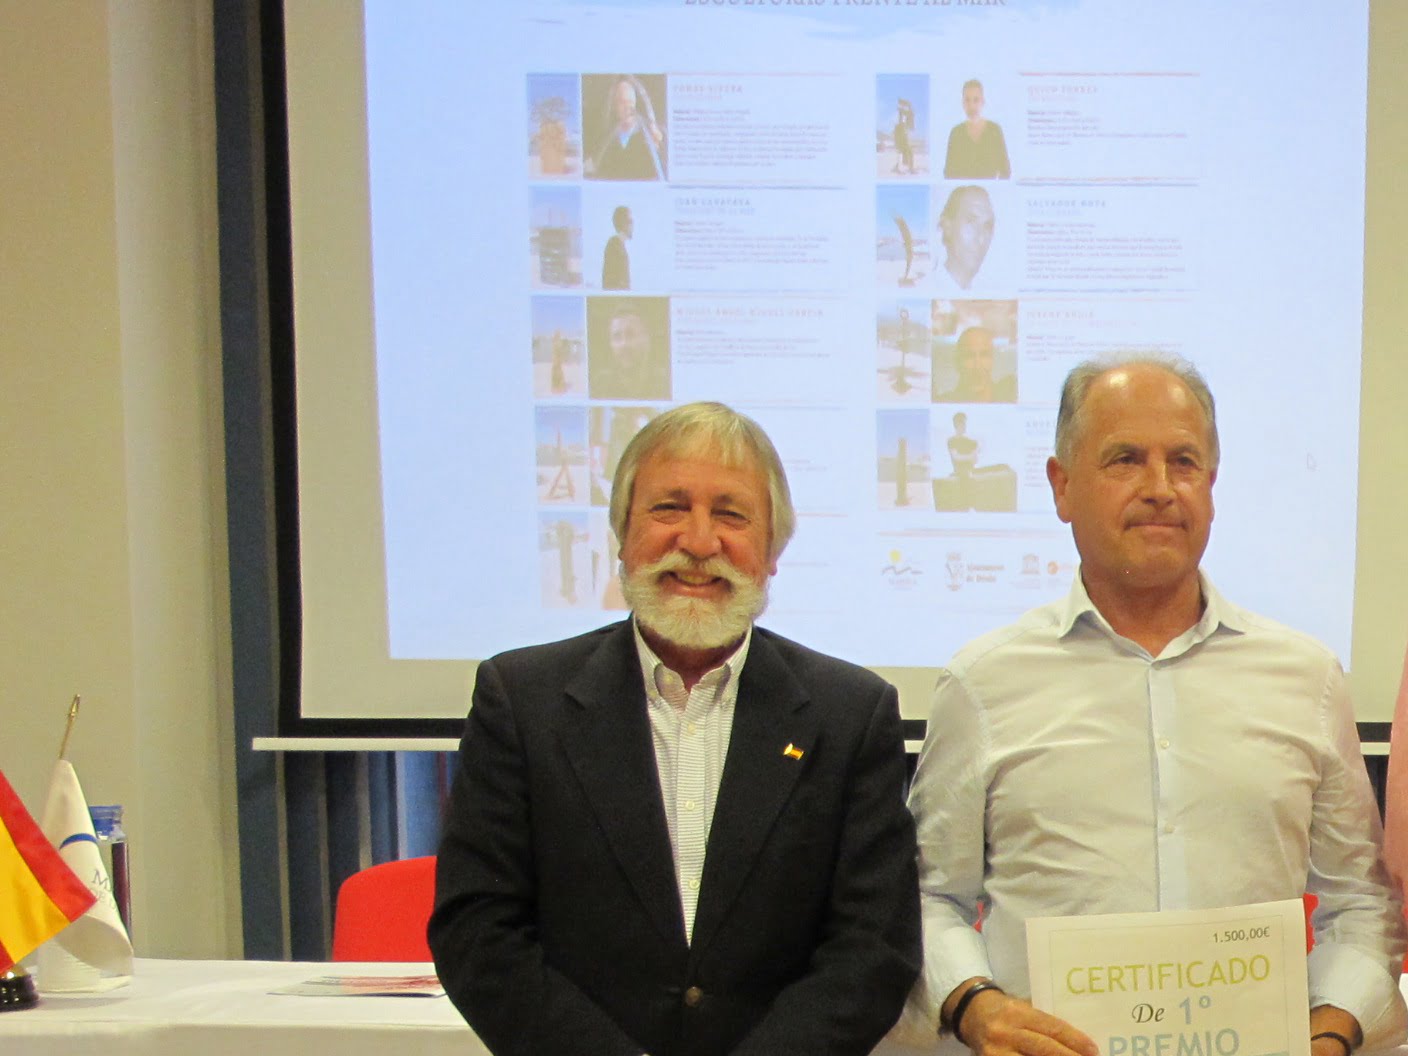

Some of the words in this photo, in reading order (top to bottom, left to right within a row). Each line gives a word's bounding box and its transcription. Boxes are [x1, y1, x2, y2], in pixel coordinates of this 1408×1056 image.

[1213, 926, 1271, 944] 1.500,00€
[1065, 954, 1271, 995] CERTIFICADO
[1131, 1003, 1166, 1024] De
